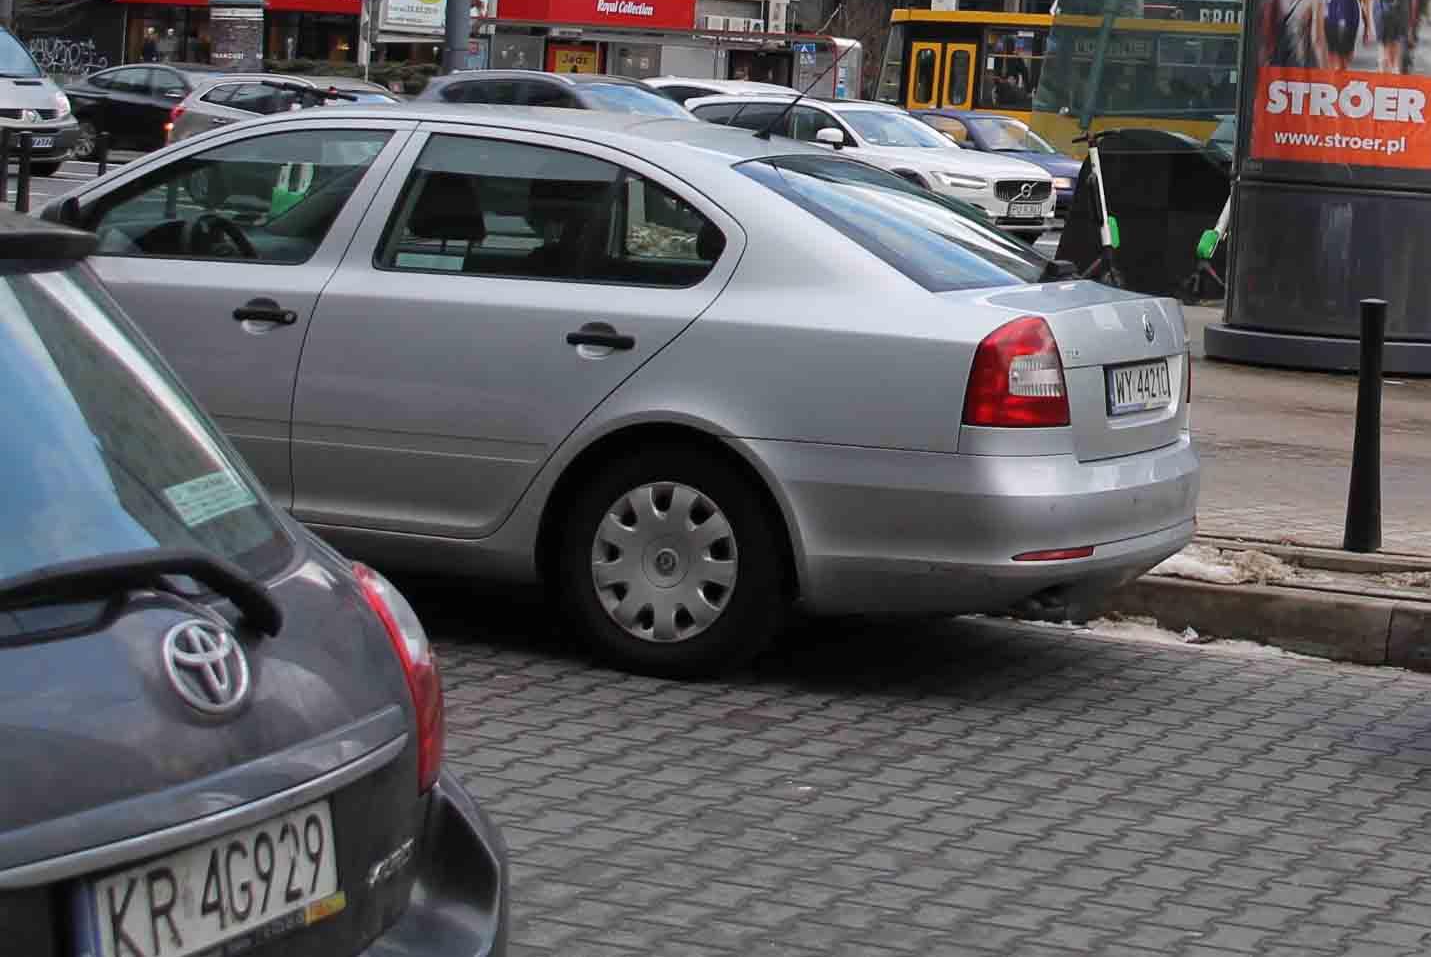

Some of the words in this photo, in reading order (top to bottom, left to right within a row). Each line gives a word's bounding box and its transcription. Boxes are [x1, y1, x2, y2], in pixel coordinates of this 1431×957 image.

[619, 1, 654, 16] Collection
[1266, 80, 1426, 124] STRÖER
[1275, 131, 1406, 155] www.stroer.pl
[1115, 370, 1133, 404] WY
[106, 866, 184, 957] KR
[201, 813, 324, 932] 4G929
